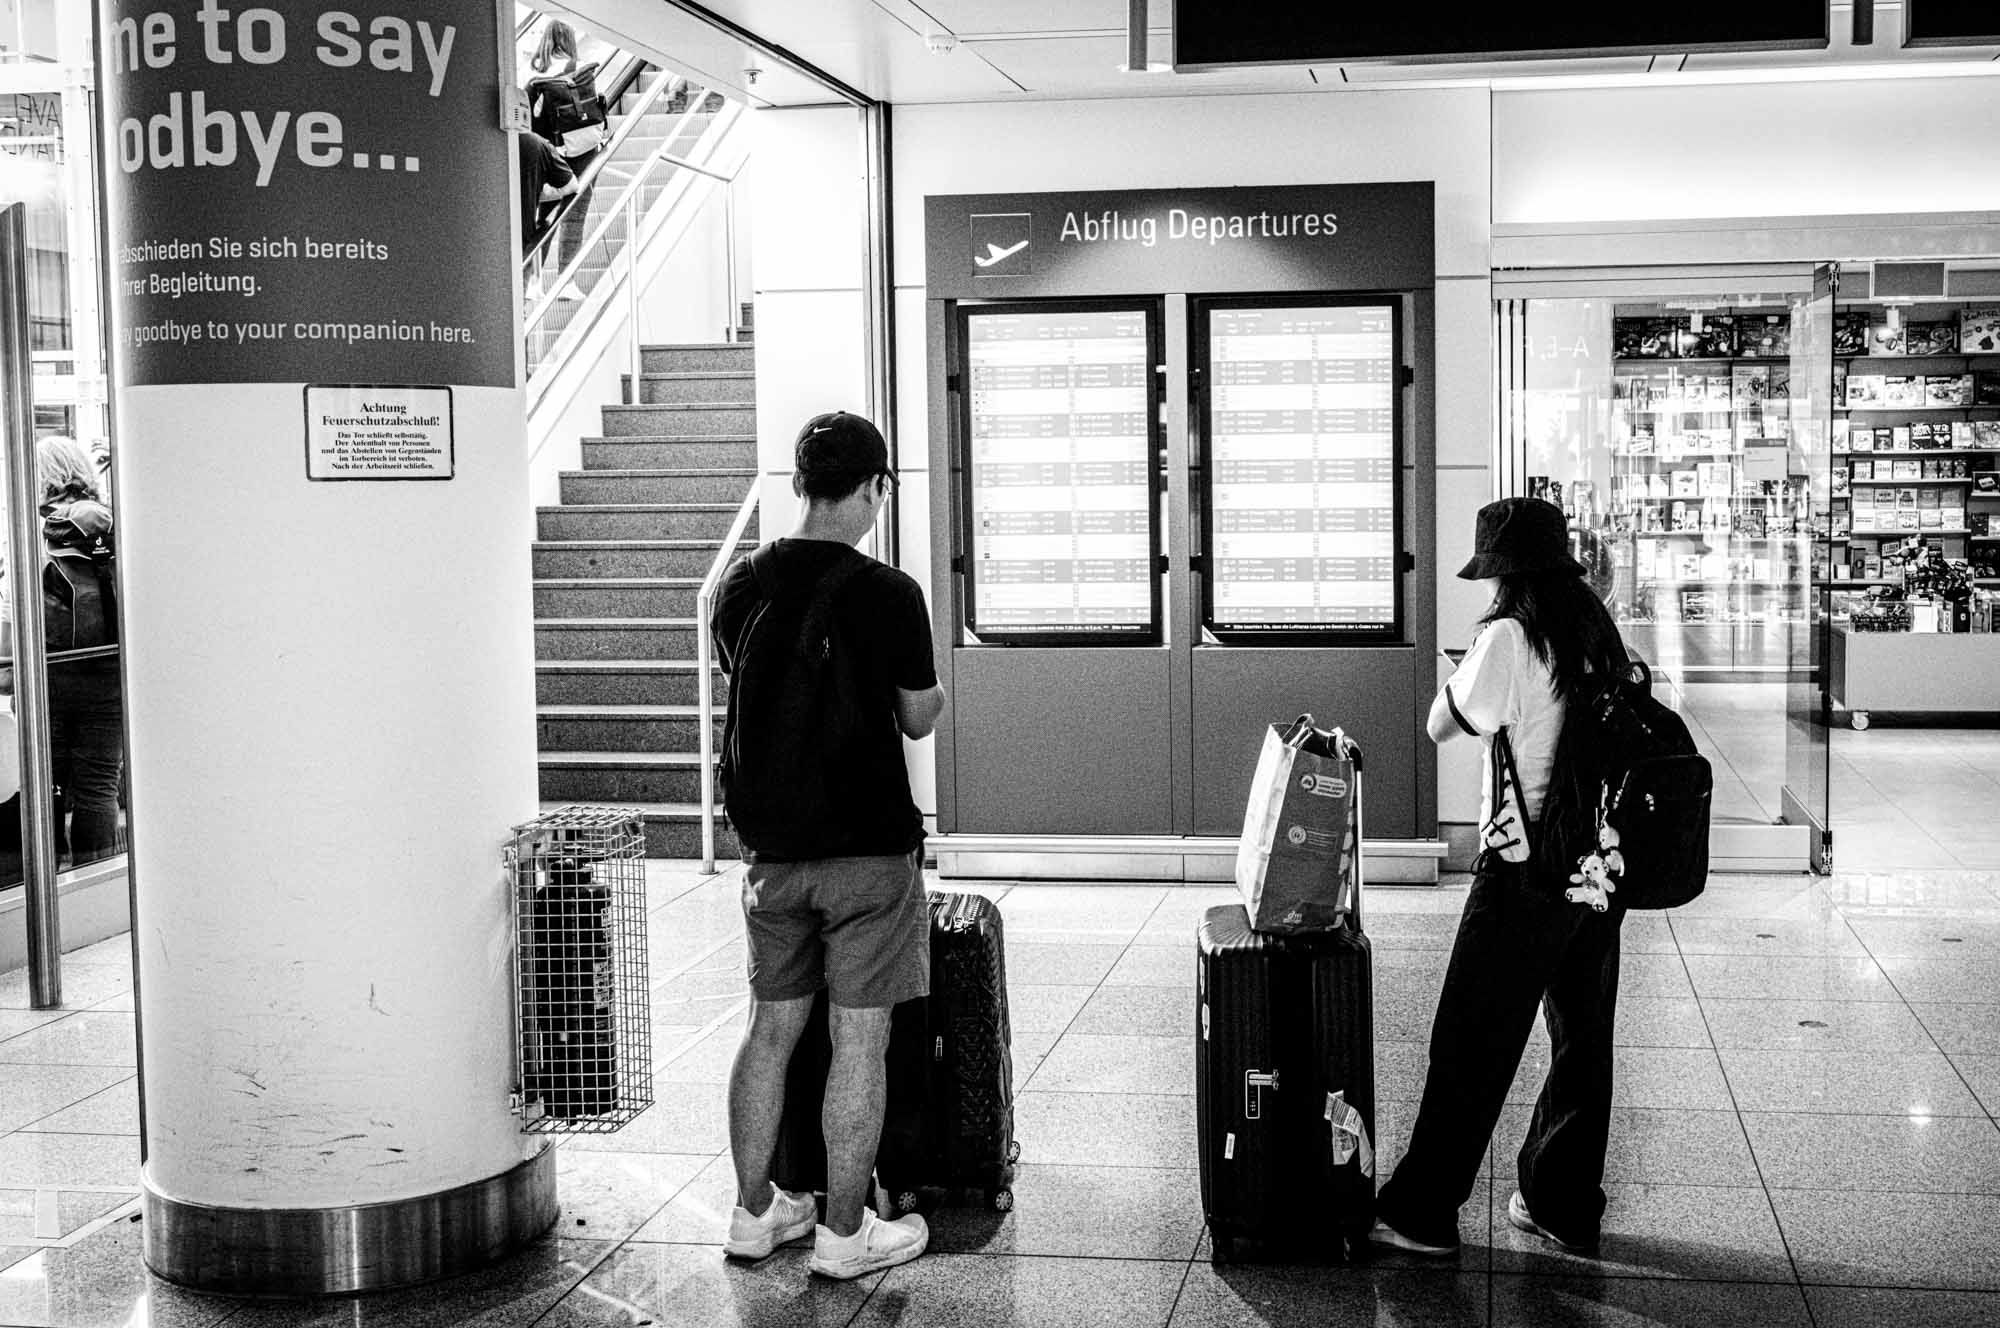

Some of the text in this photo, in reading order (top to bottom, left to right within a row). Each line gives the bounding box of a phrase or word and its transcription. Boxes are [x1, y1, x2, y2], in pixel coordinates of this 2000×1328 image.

[197, 0, 286, 64] to
[316, 11, 456, 96] say
[1060, 208, 1338, 247] Abflug Departures
[209, 236, 242, 258] Sie
[250, 236, 297, 258] sich
[305, 236, 388, 260] bereits
[150, 271, 262, 298] Begleitung.
[135, 320, 201, 347] goodbye
[208, 321, 229, 339] to
[235, 323, 287, 345] your
[294, 320, 424, 344] companion
[431, 321, 475, 343] here.
[322, 415, 440, 427] Feuerschutzabschluß!
[360, 402, 407, 414] Achtung
